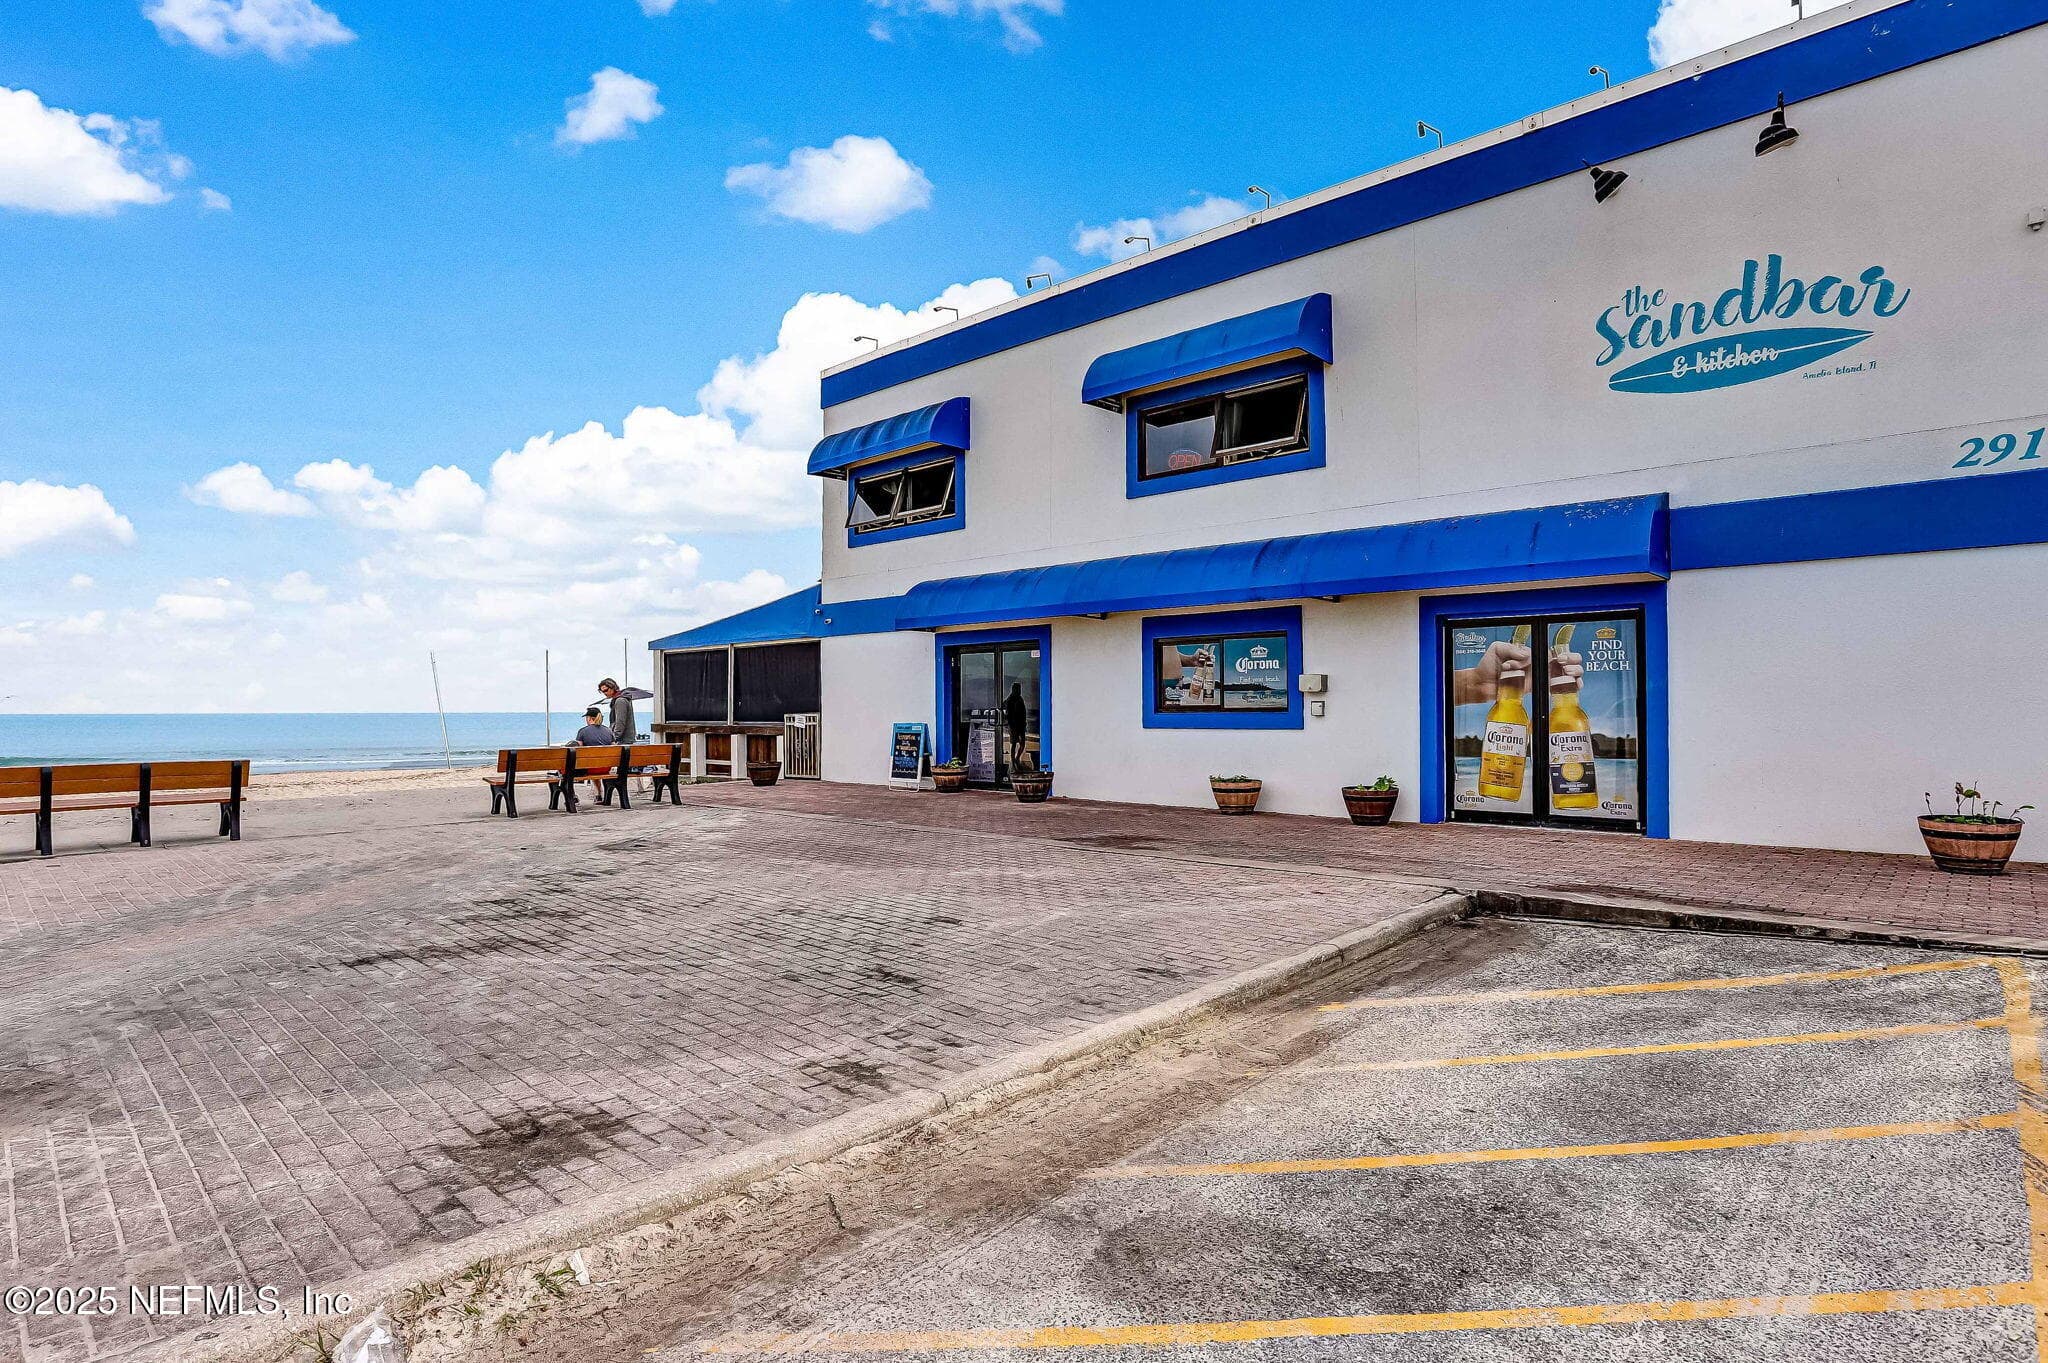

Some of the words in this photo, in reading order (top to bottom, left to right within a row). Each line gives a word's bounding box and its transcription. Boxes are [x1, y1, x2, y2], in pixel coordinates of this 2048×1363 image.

[1621, 285, 1669, 318] the
[1595, 253, 1911, 367] Sandbar
[1671, 355, 1688, 379] &
[1695, 343, 1779, 373] kitchen
[1802, 369, 1832, 380] Amelia
[1951, 427, 2046, 469] 291
[1168, 454, 1202, 470] OPEN
[1591, 640, 1623, 650] FIND
[1588, 650, 1626, 661] YOUR
[1235, 656, 1280, 674] Corona
[1586, 661, 1632, 672] BEACH
[1487, 730, 1524, 745] Corona
[1550, 734, 1589, 746] Corona
[1560, 744, 1583, 752] Extra
[1456, 794, 1485, 804] Corona
[1601, 800, 1633, 811] Corona
